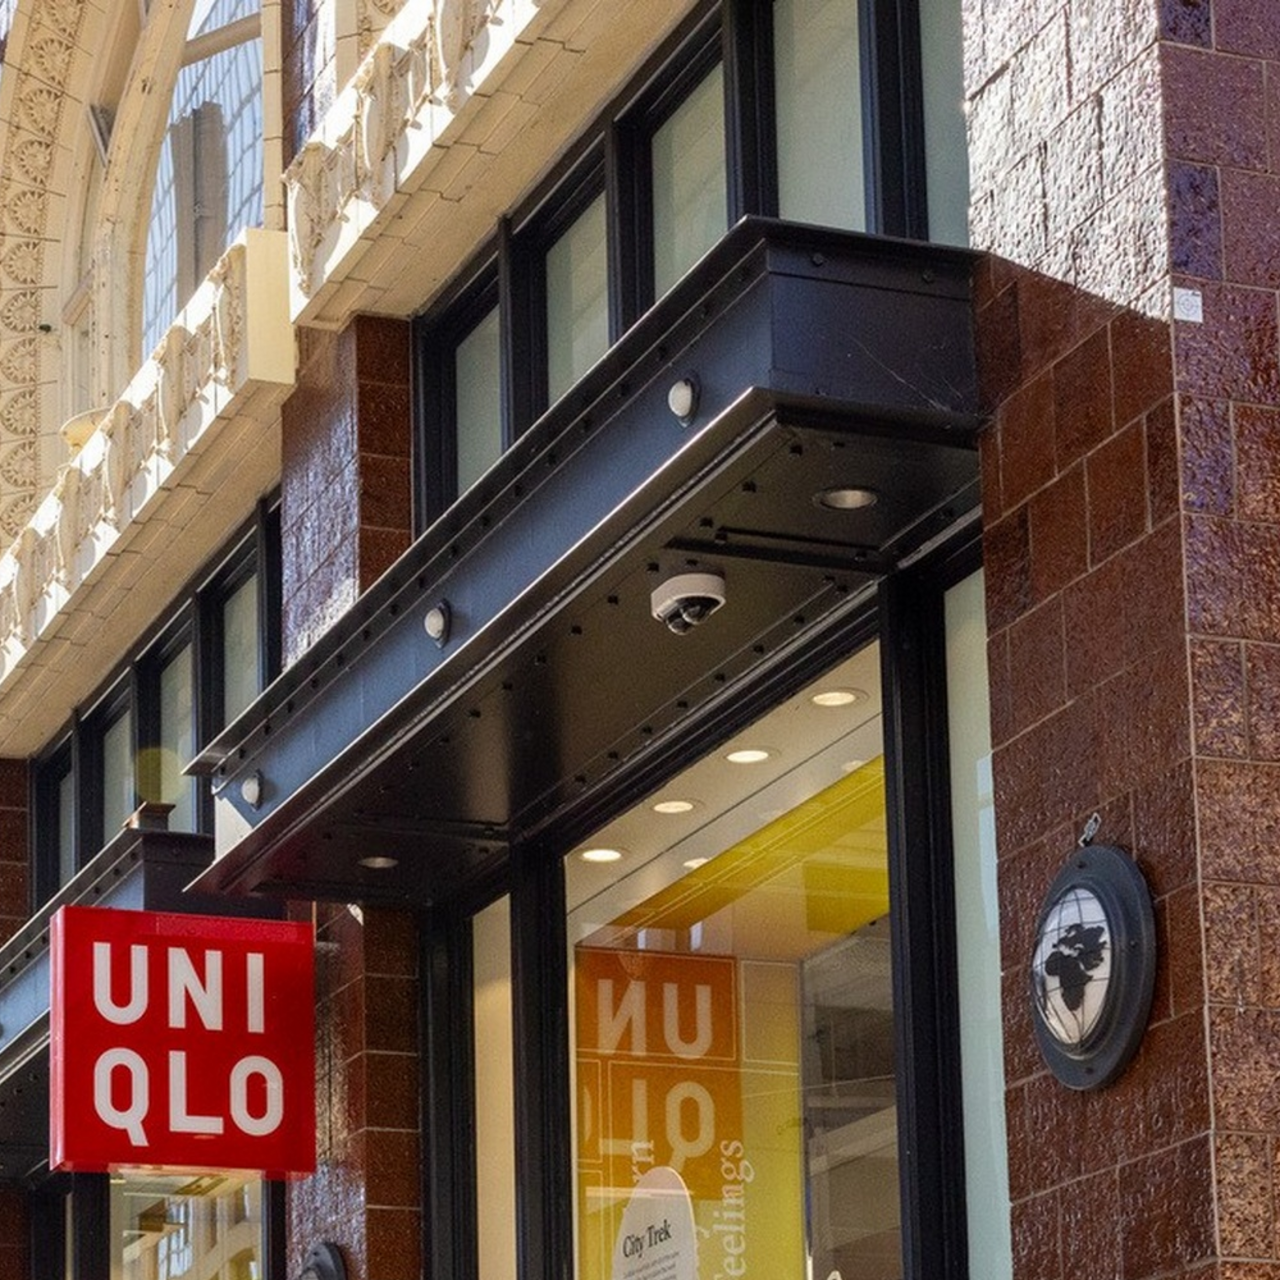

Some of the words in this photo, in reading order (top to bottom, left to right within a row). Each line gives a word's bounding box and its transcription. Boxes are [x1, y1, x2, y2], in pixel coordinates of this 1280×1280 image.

[92, 941, 265, 1034] UNI
[92, 1046, 285, 1147] QLO
[623, 1234, 645, 1258] City
[648, 1218, 672, 1248] Trek
